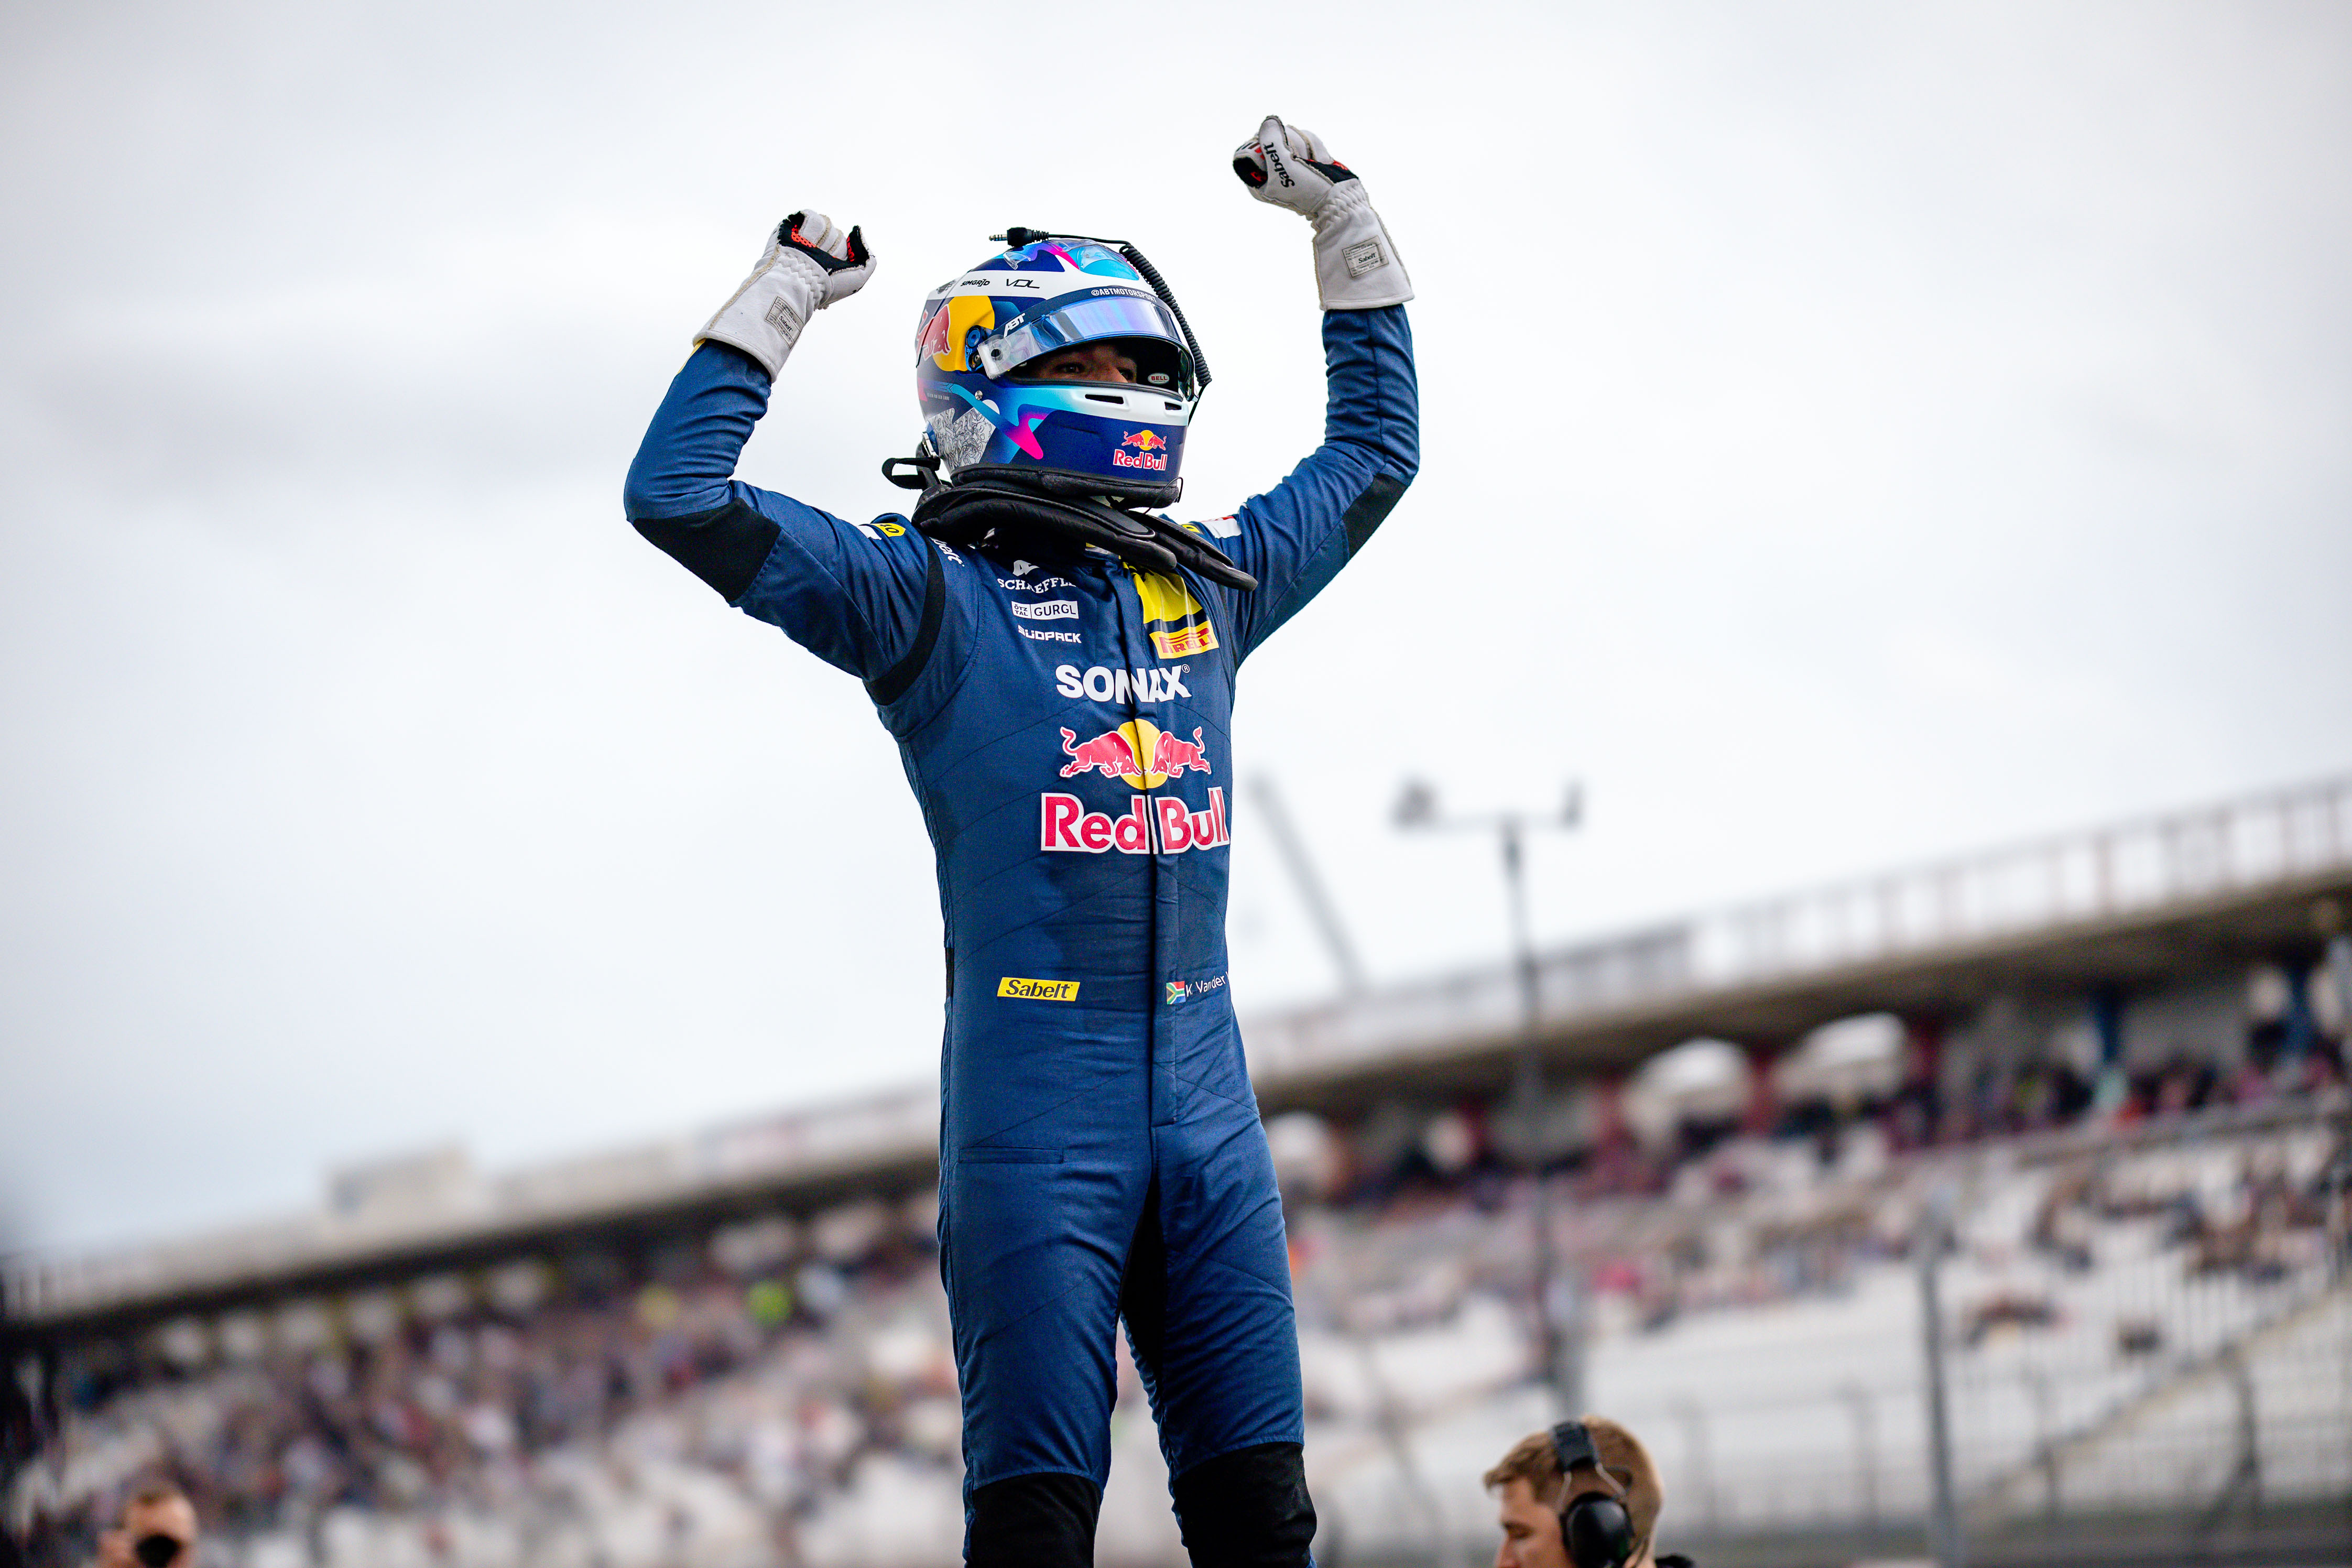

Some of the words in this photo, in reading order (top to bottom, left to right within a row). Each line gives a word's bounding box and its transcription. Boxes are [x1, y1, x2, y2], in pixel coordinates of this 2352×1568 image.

[1263, 142, 1295, 188] Sabelt
[1358, 252, 1376, 264] Sabelt
[1091, 288, 1157, 303] @ABTMOTORSPORT
[779, 315, 792, 332] Sabelt
[1004, 313, 1026, 338] ABT
[1113, 449, 1144, 468] Red
[1143, 453, 1168, 471] Bull
[929, 537, 963, 564] belt
[997, 578, 1076, 593] SCHAEFFL
[1034, 604, 1076, 616] GURGL
[1018, 625, 1082, 644] SÜDPACK
[1159, 627, 1213, 654] PIRELLI
[1041, 793, 1150, 854] Red
[1155, 786, 1229, 855] Bull
[1006, 979, 1070, 999] Sabelt
